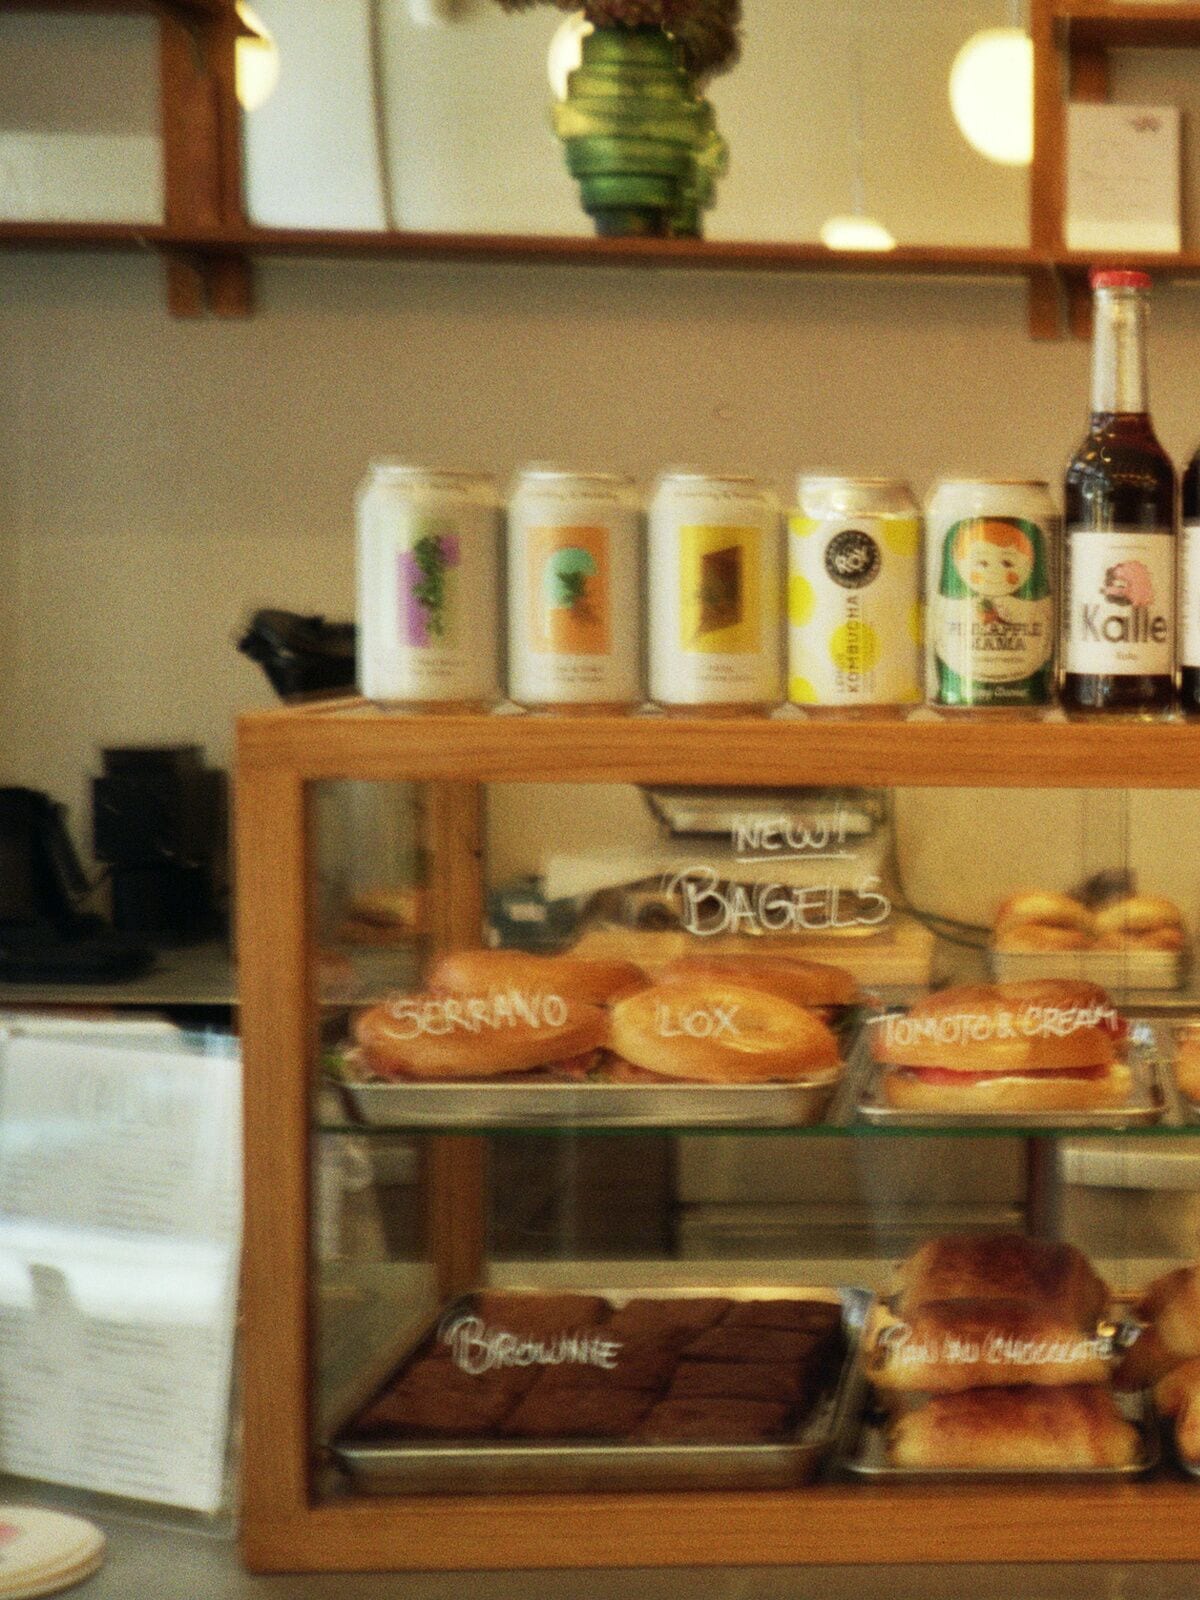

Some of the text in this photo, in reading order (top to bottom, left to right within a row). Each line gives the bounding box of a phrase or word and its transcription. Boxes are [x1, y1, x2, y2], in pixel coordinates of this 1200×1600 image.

[845, 594, 861, 694] KOMBUCHA
[1080, 602, 1169, 644] Kalle
[731, 809, 851, 852] NEW!
[665, 865, 892, 937] BAGELS
[383, 989, 568, 1041] SERRANO
[653, 1002, 743, 1039] LOX
[1020, 1002, 1121, 1037] CREAM
[443, 1314, 624, 1376] BROWNIE
